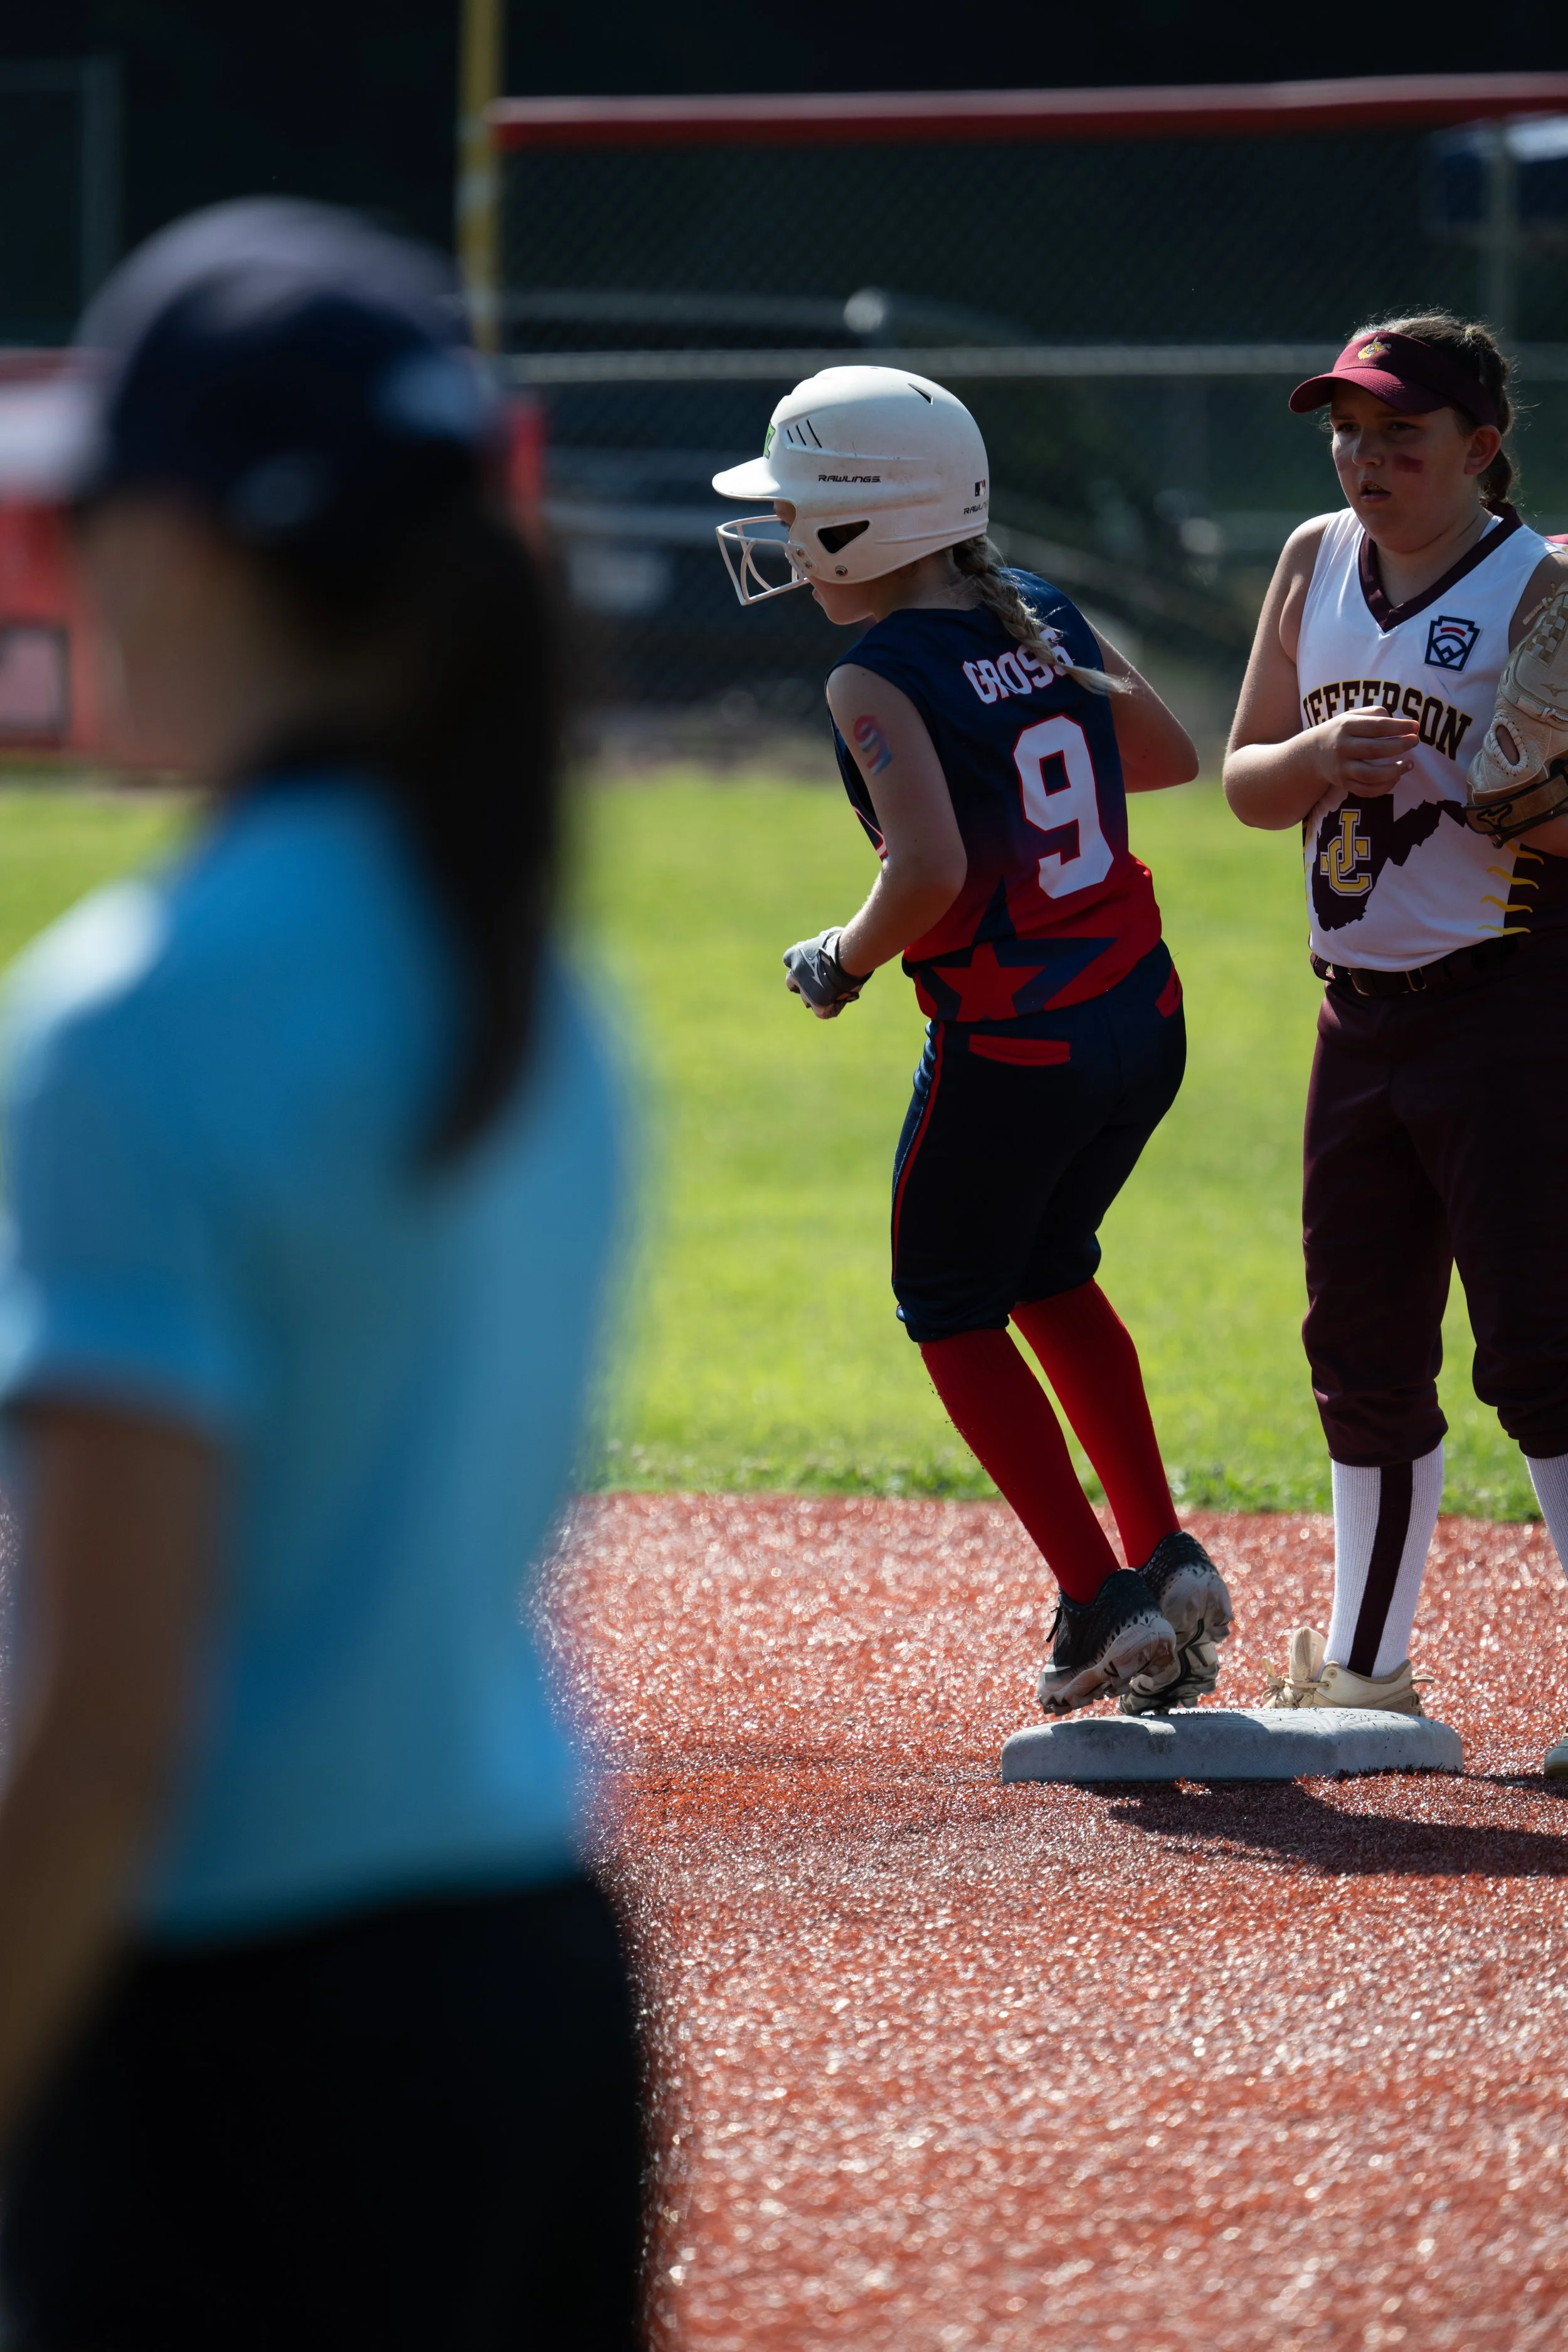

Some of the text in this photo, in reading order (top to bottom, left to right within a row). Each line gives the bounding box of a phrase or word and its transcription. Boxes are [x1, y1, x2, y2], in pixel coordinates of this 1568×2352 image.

[818, 475, 881, 483] RAWLINGS
[962, 628, 1074, 704] GROSS
[1302, 679, 1473, 761] JEFFERSON
[1012, 712, 1115, 900] 9
